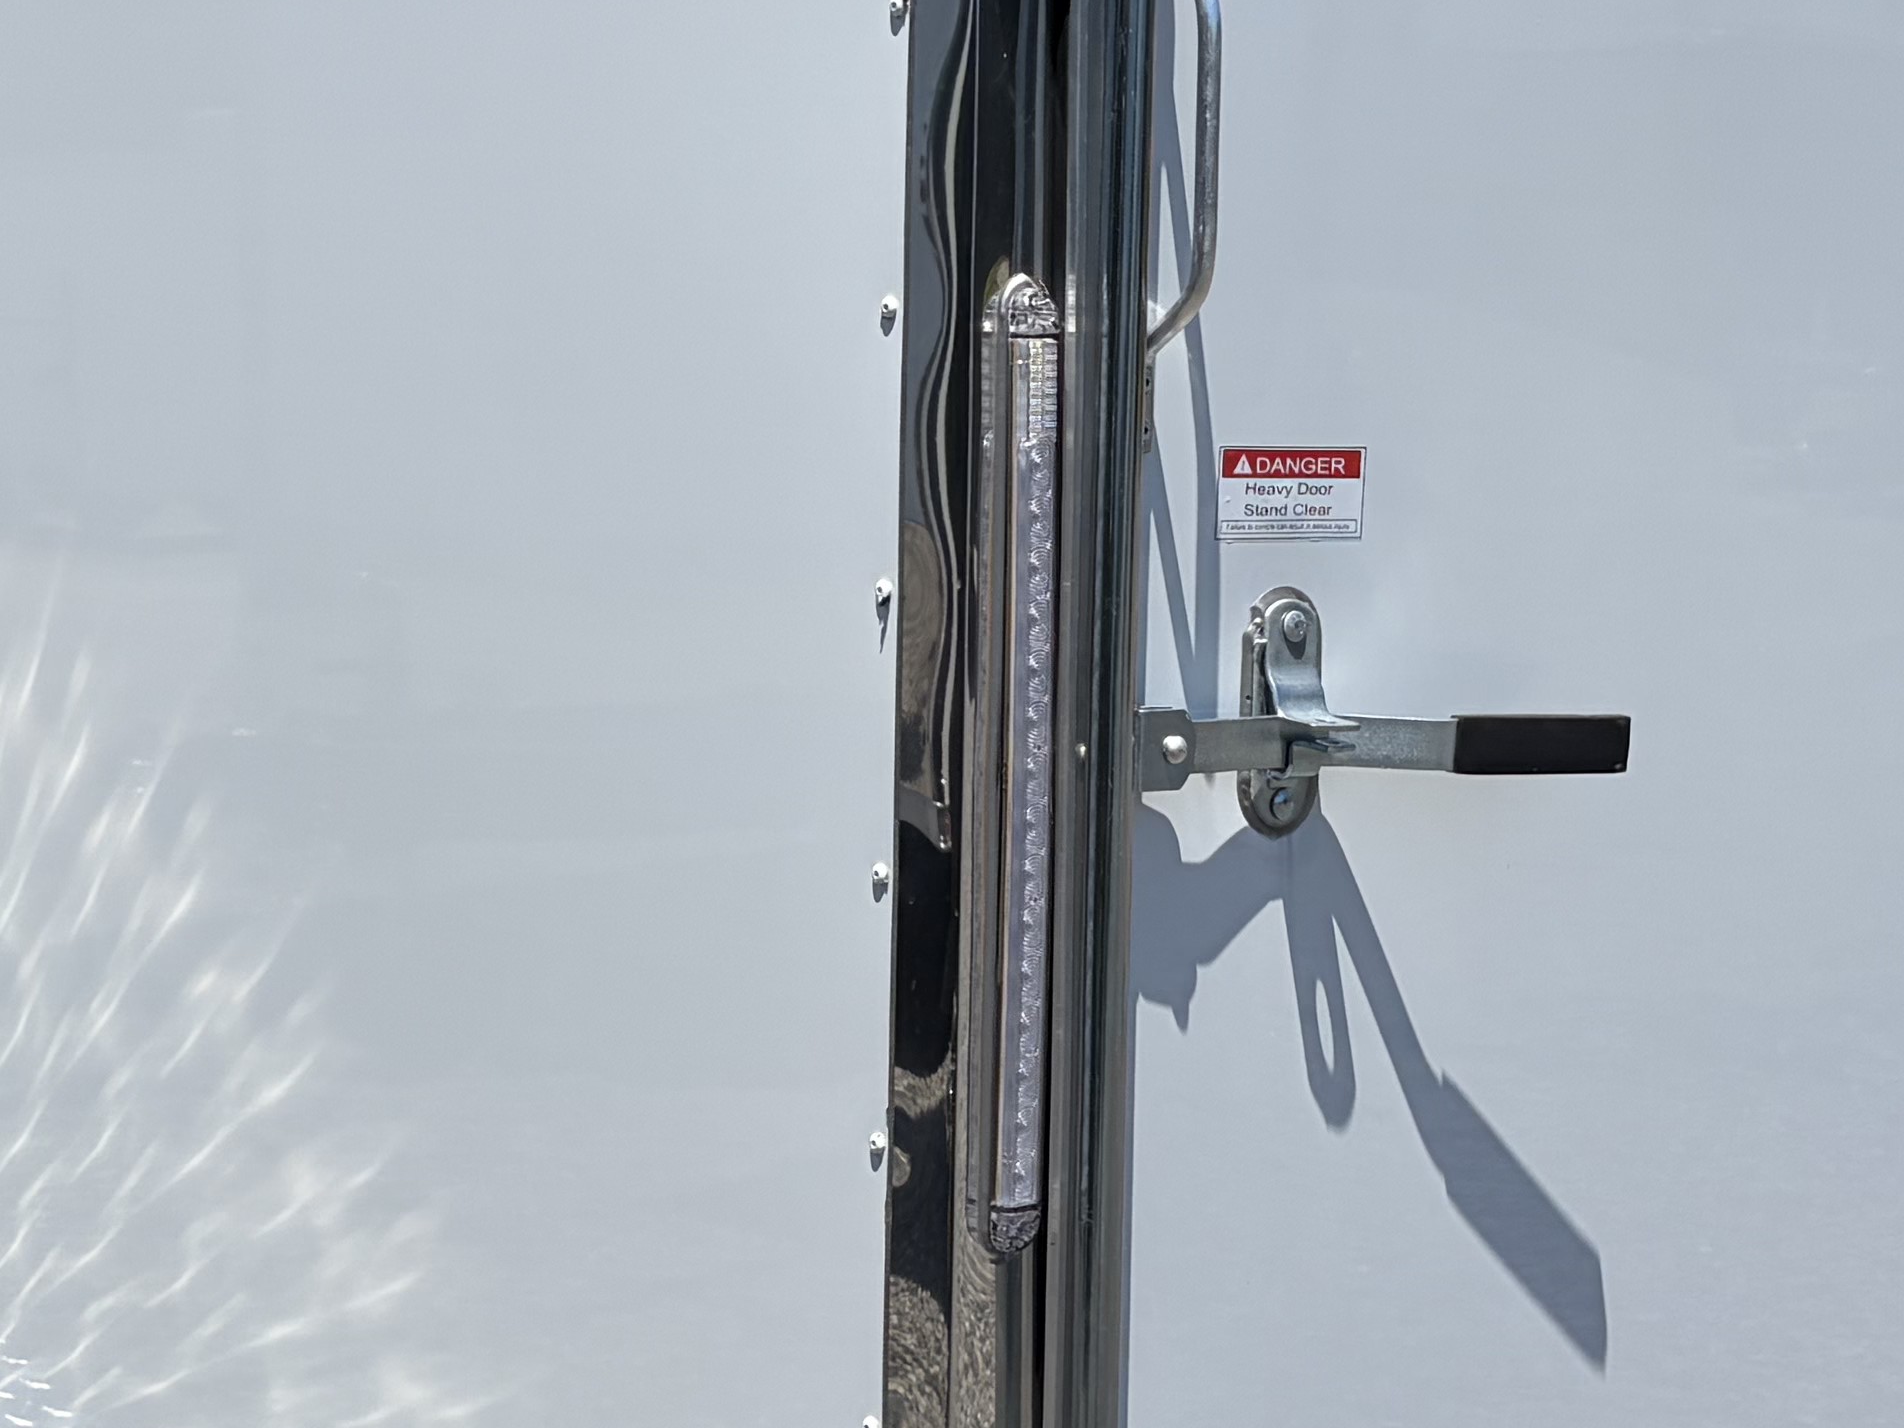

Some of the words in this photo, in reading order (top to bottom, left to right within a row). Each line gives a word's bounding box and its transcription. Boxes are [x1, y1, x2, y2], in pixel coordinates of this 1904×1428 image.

[1256, 456, 1346, 475] DANGER
[1245, 482, 1293, 498] Heavy
[1297, 482, 1334, 496] Door
[1243, 503, 1288, 517] Stand
[1292, 503, 1333, 517] Clear
